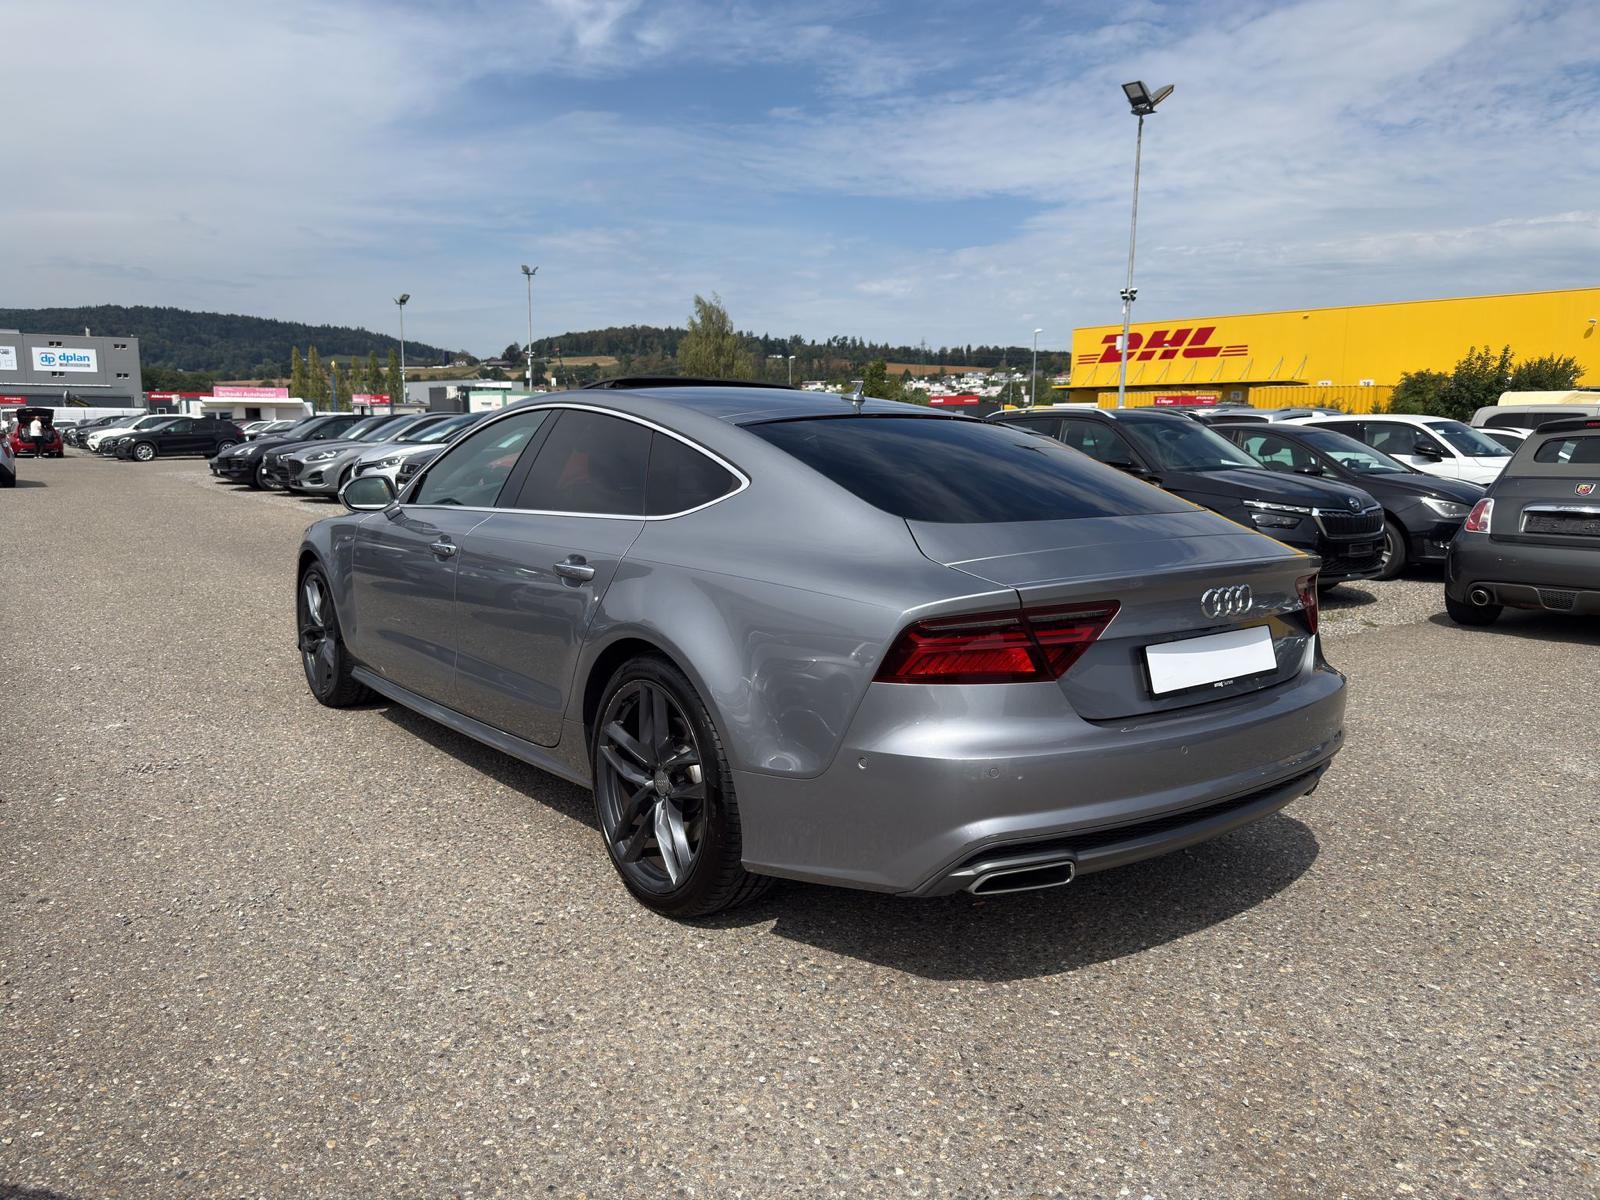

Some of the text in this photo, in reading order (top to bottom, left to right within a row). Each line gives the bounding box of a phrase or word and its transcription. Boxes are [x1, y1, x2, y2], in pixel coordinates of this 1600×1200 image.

[1098, 327, 1223, 364] DHL
[40, 352, 90, 364] dp dplan
